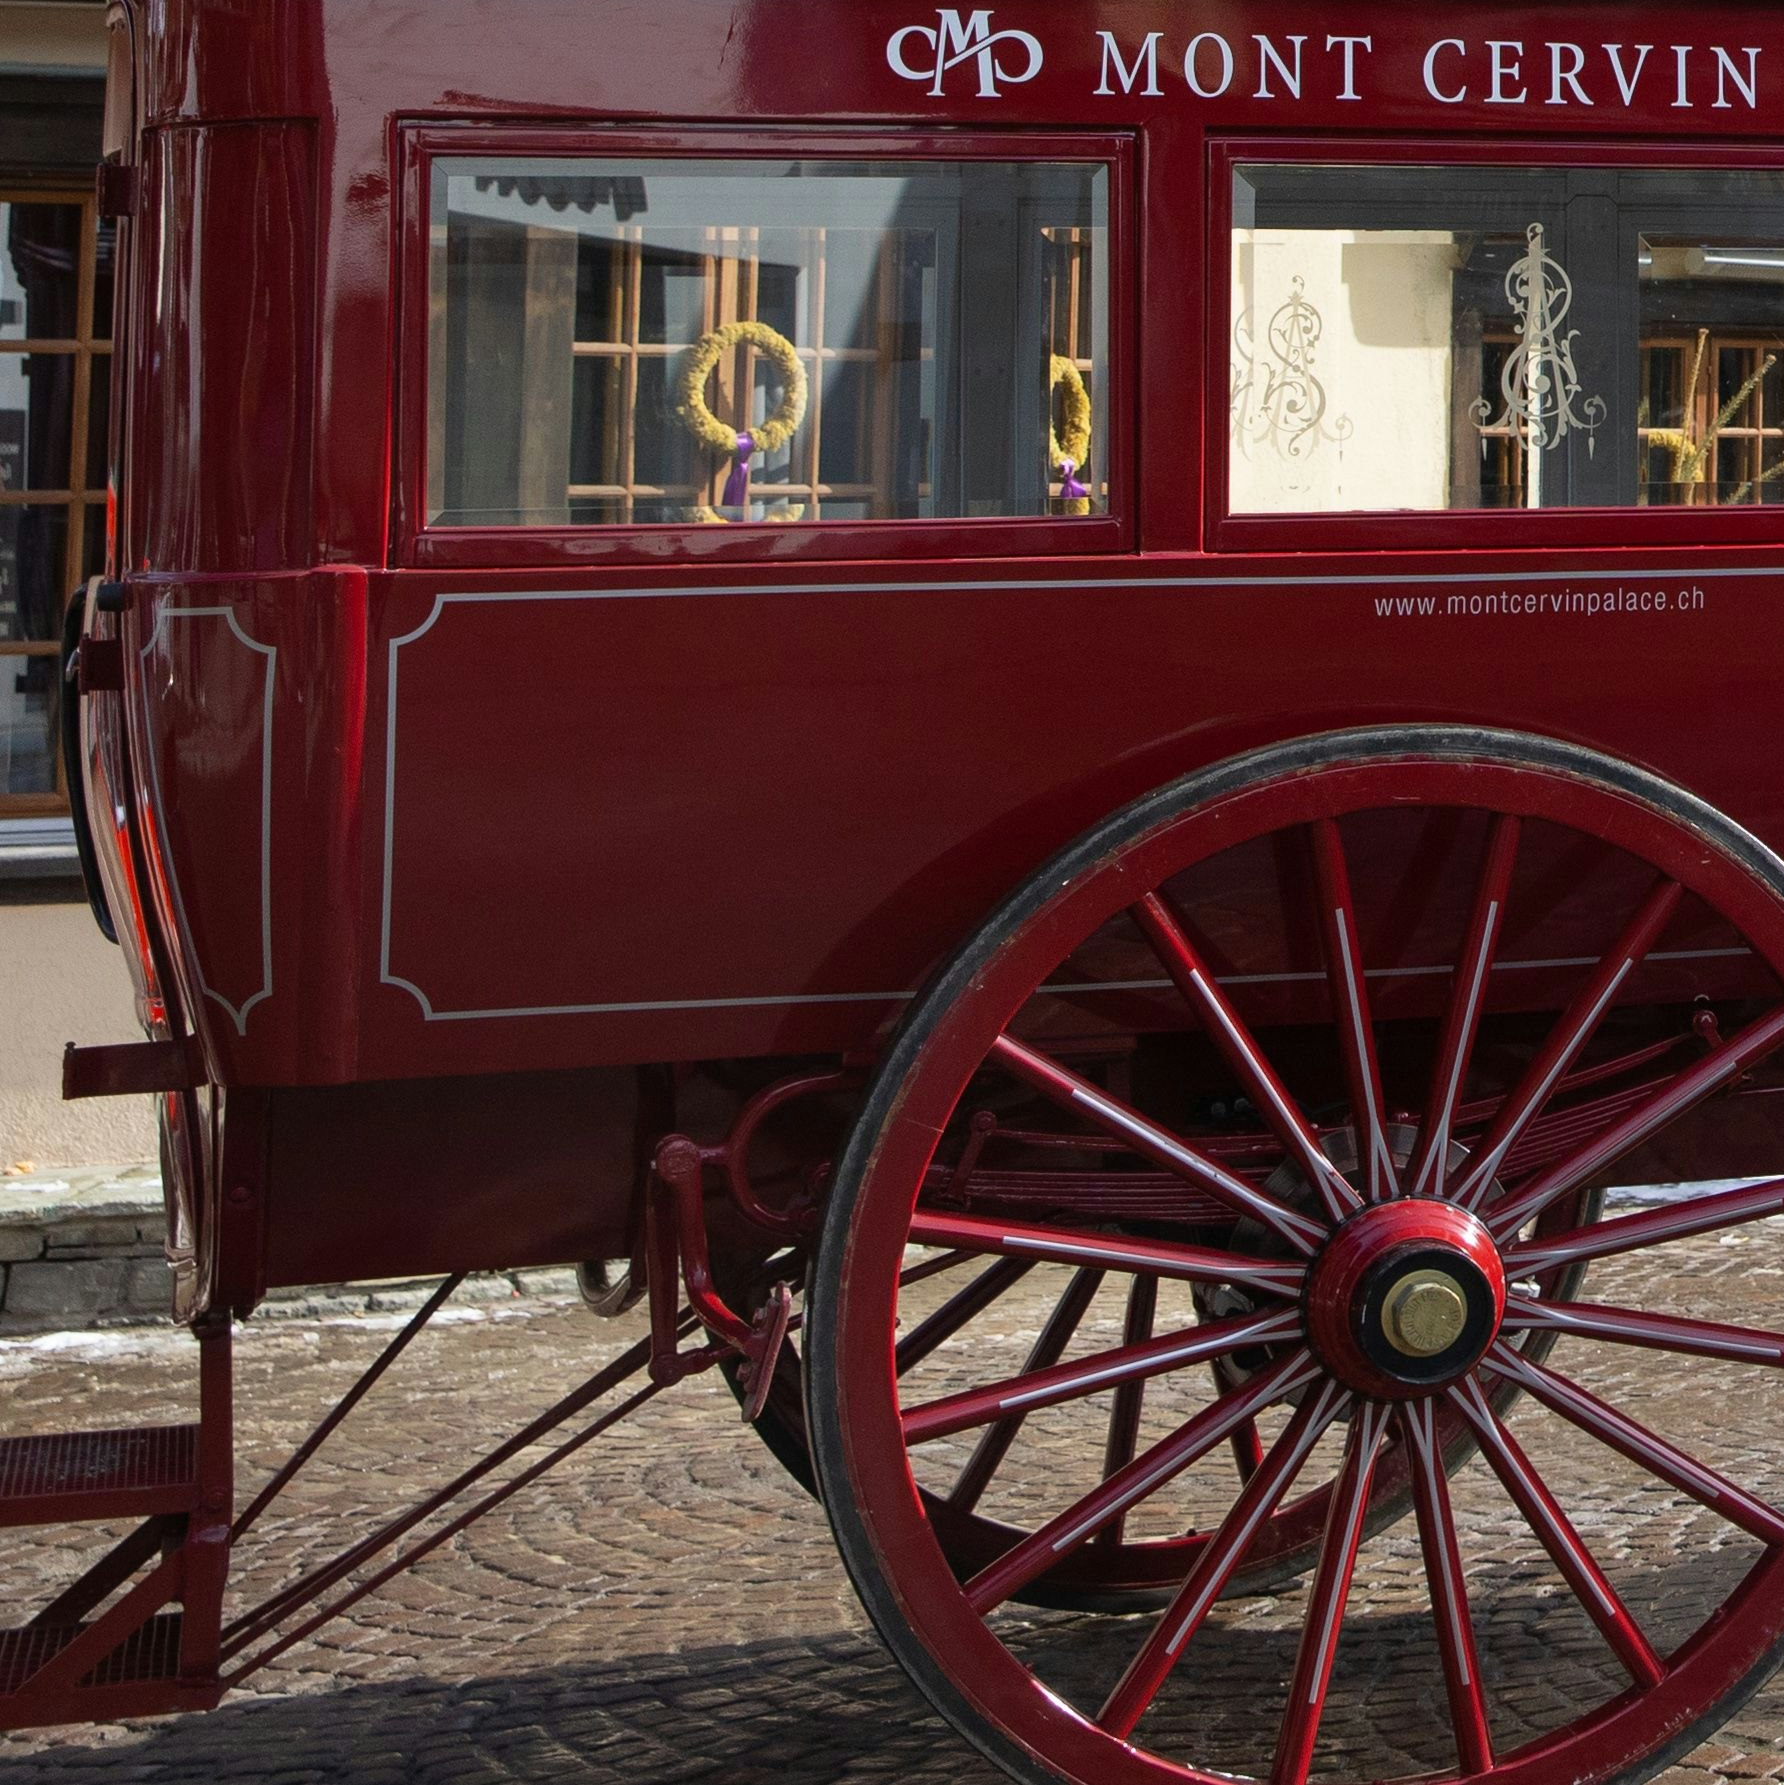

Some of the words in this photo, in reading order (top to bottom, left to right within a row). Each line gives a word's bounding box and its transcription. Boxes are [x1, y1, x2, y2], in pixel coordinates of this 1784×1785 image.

[1092, 30, 1372, 100] MONT
[1423, 38, 1762, 109] CERVIN
[1374, 585, 1704, 616] www.montcervinpalace.ch
